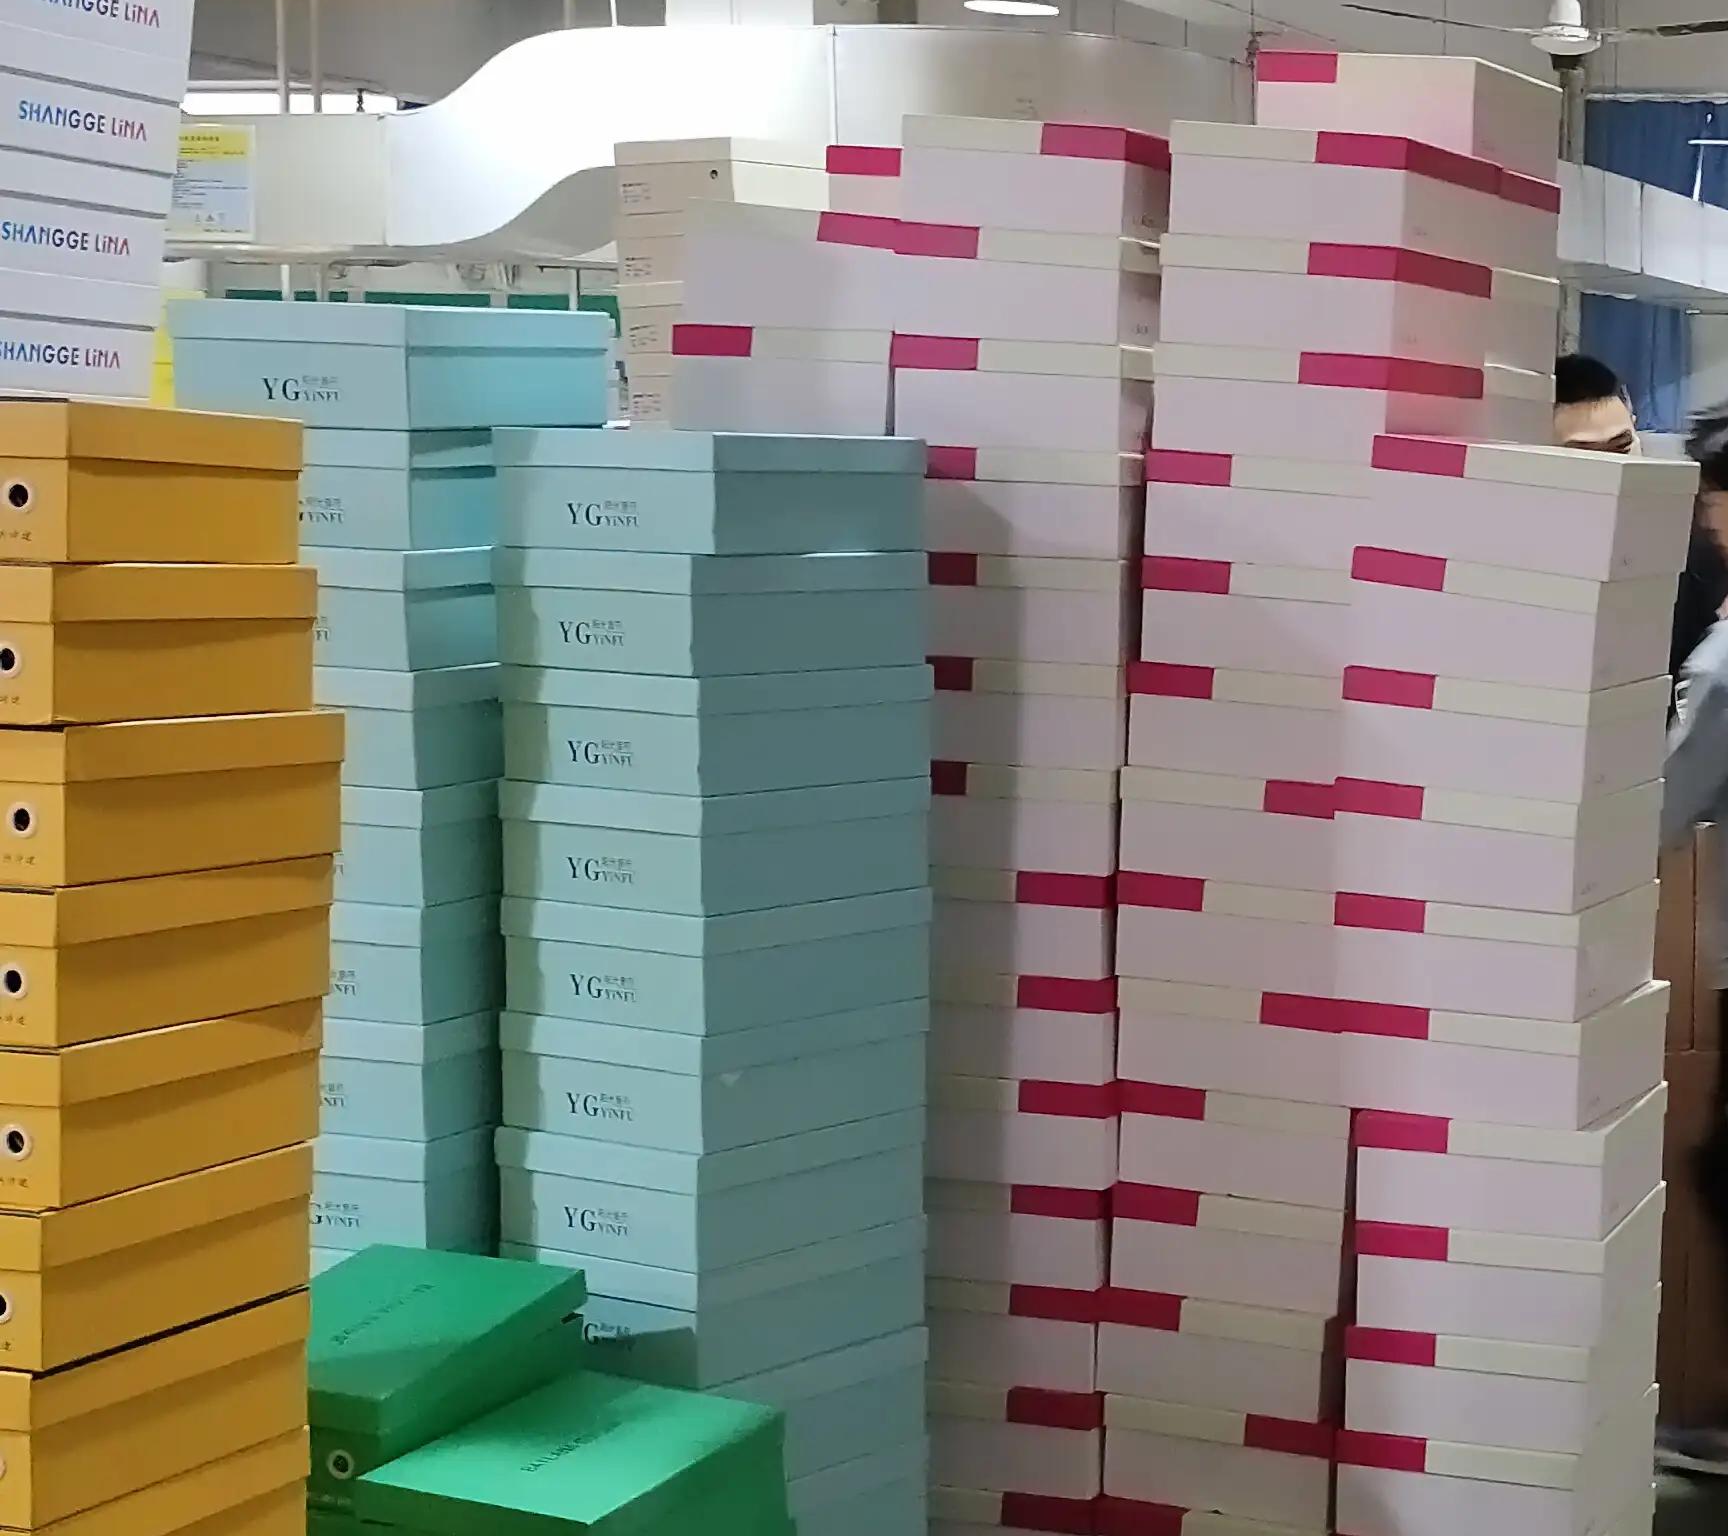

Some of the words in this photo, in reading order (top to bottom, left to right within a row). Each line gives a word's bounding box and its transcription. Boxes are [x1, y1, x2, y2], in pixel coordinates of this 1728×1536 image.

[18, 99, 106, 134] SHANGGE
[1, 221, 89, 252] SHANGGE
[262, 376, 300, 402] YG
[566, 501, 602, 527] YG
[558, 620, 592, 645] YG
[568, 739, 600, 765] YG
[567, 856, 601, 881] YG
[569, 972, 603, 999] YG
[566, 1091, 599, 1117] YG
[563, 1205, 597, 1232] YG
